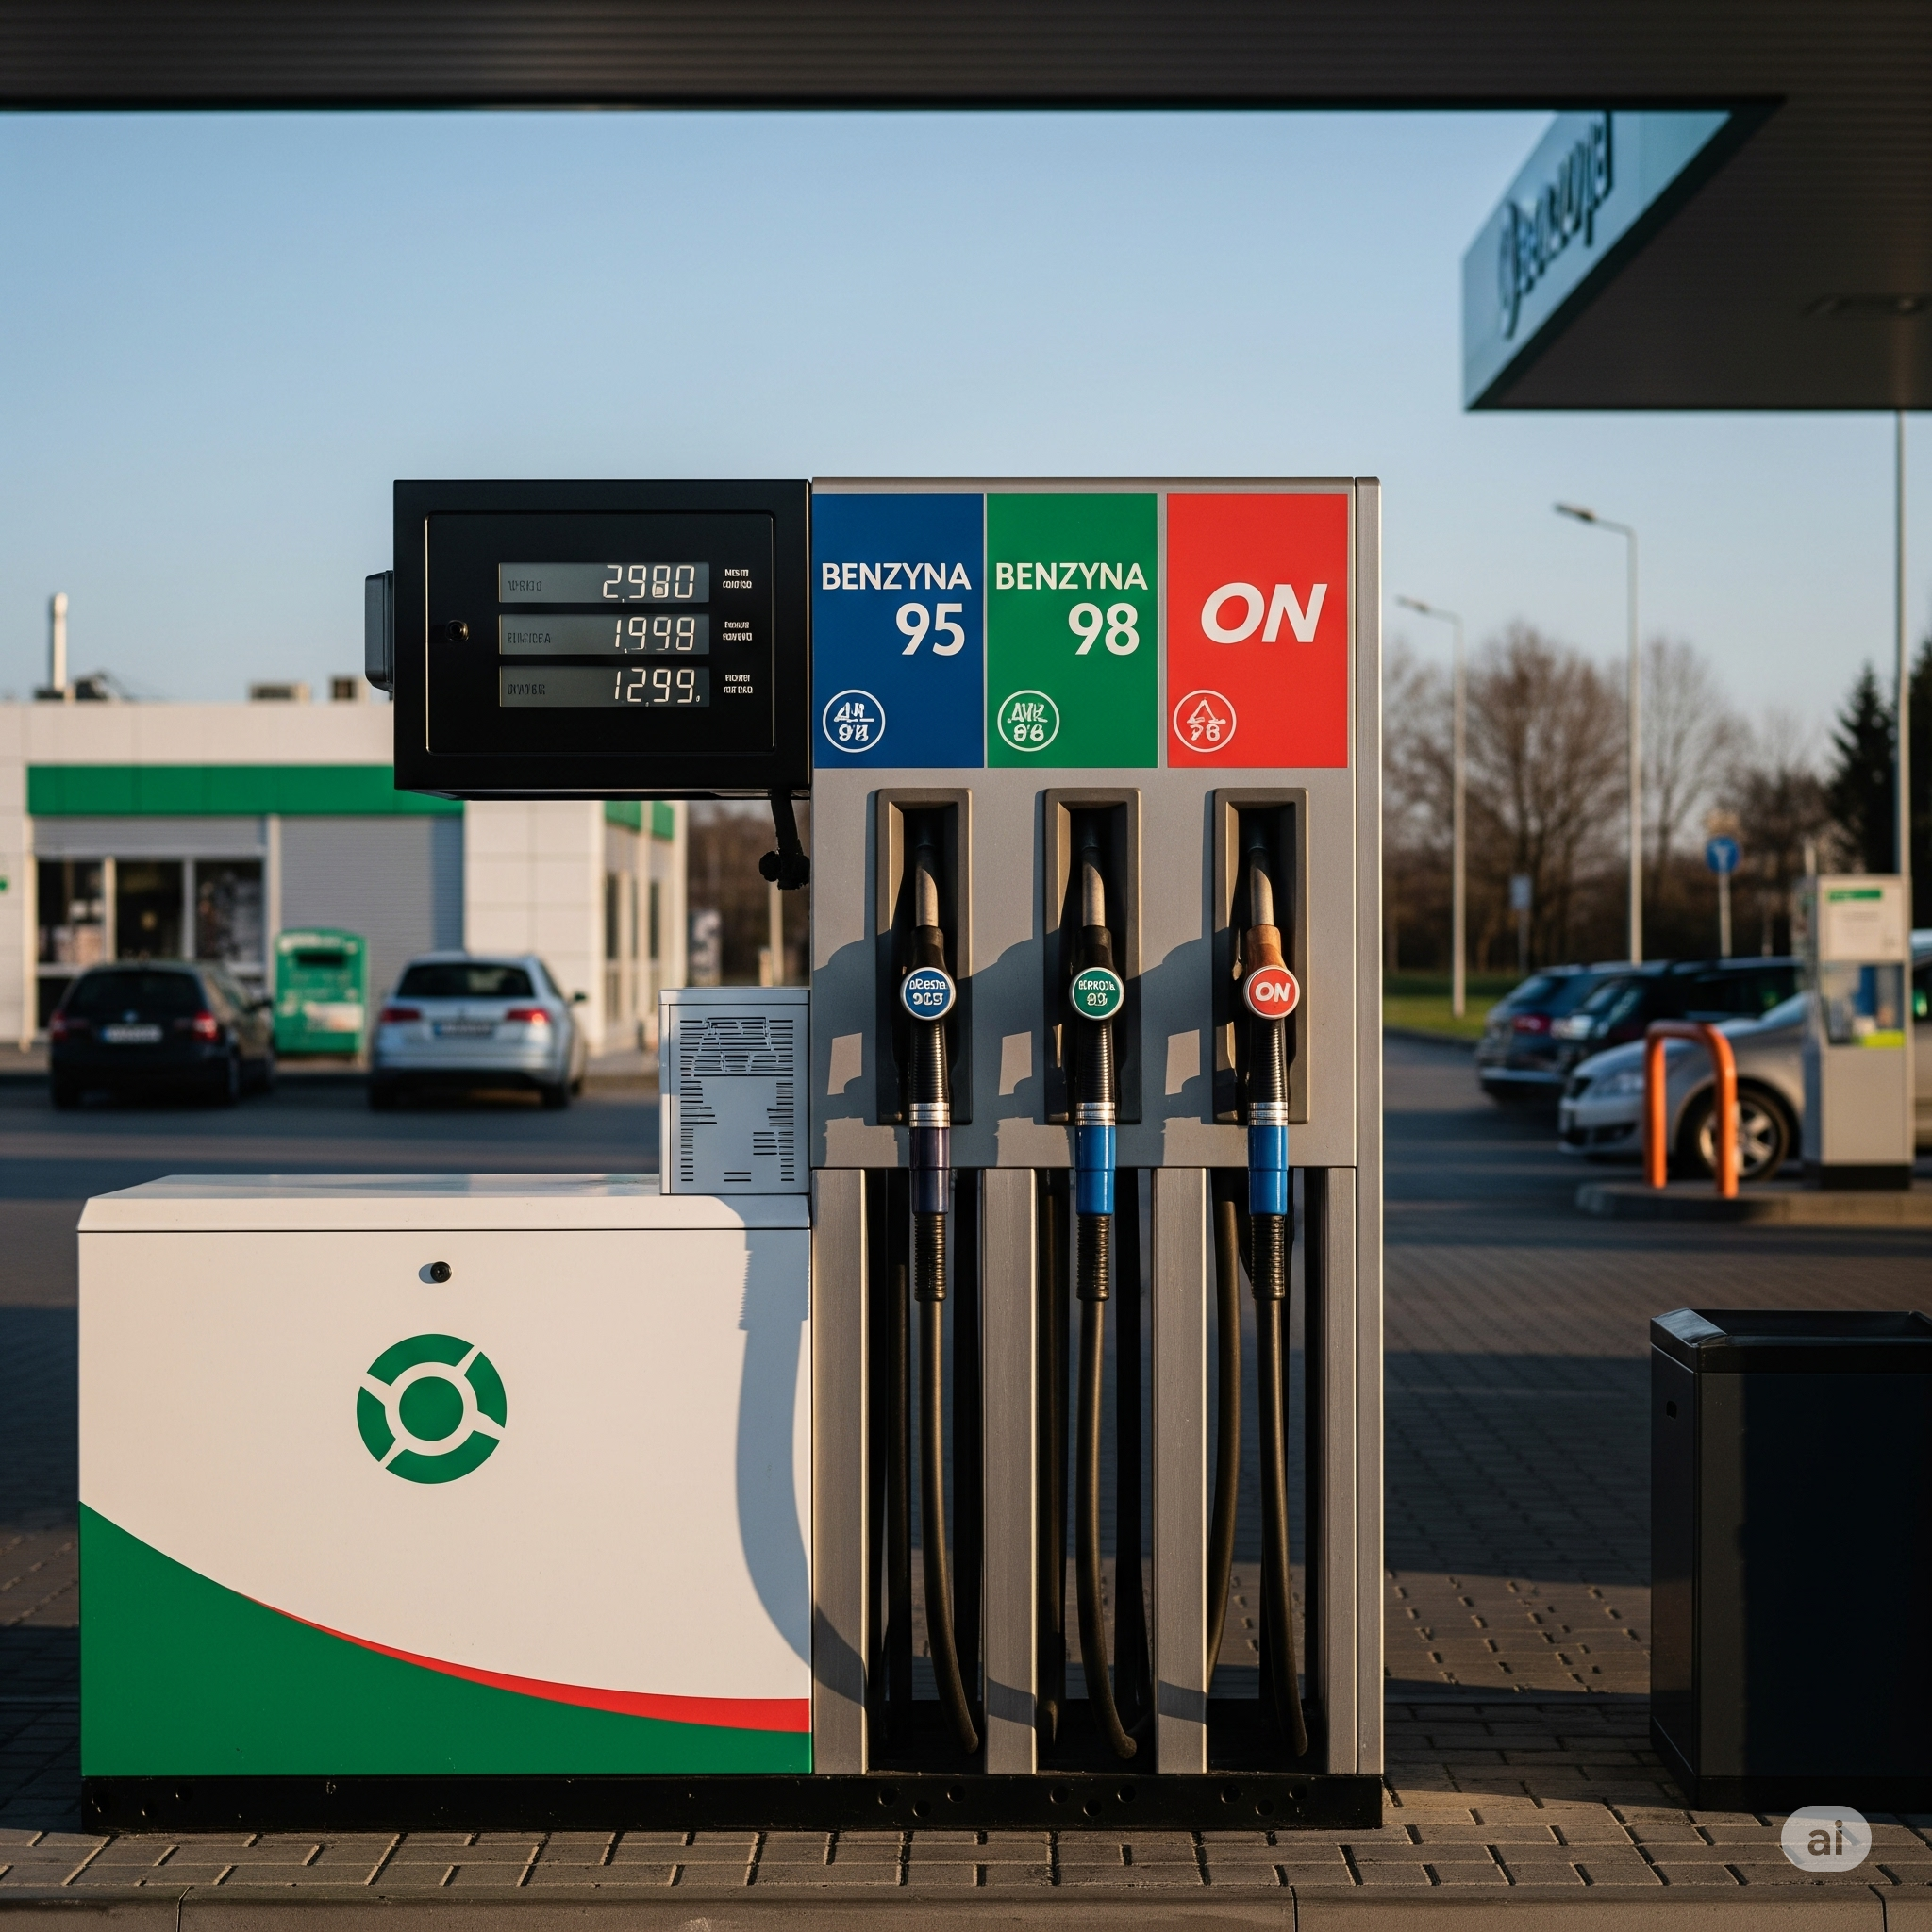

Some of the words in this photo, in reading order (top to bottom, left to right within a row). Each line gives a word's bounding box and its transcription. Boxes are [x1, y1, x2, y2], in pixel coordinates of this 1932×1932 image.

[822, 562, 972, 591] BENZYNA
[996, 562, 1148, 591] BENZYNA
[895, 602, 965, 657] 95
[1068, 602, 1140, 656] 98
[1201, 582, 1328, 644] ON
[1255, 981, 1291, 1003] ON
